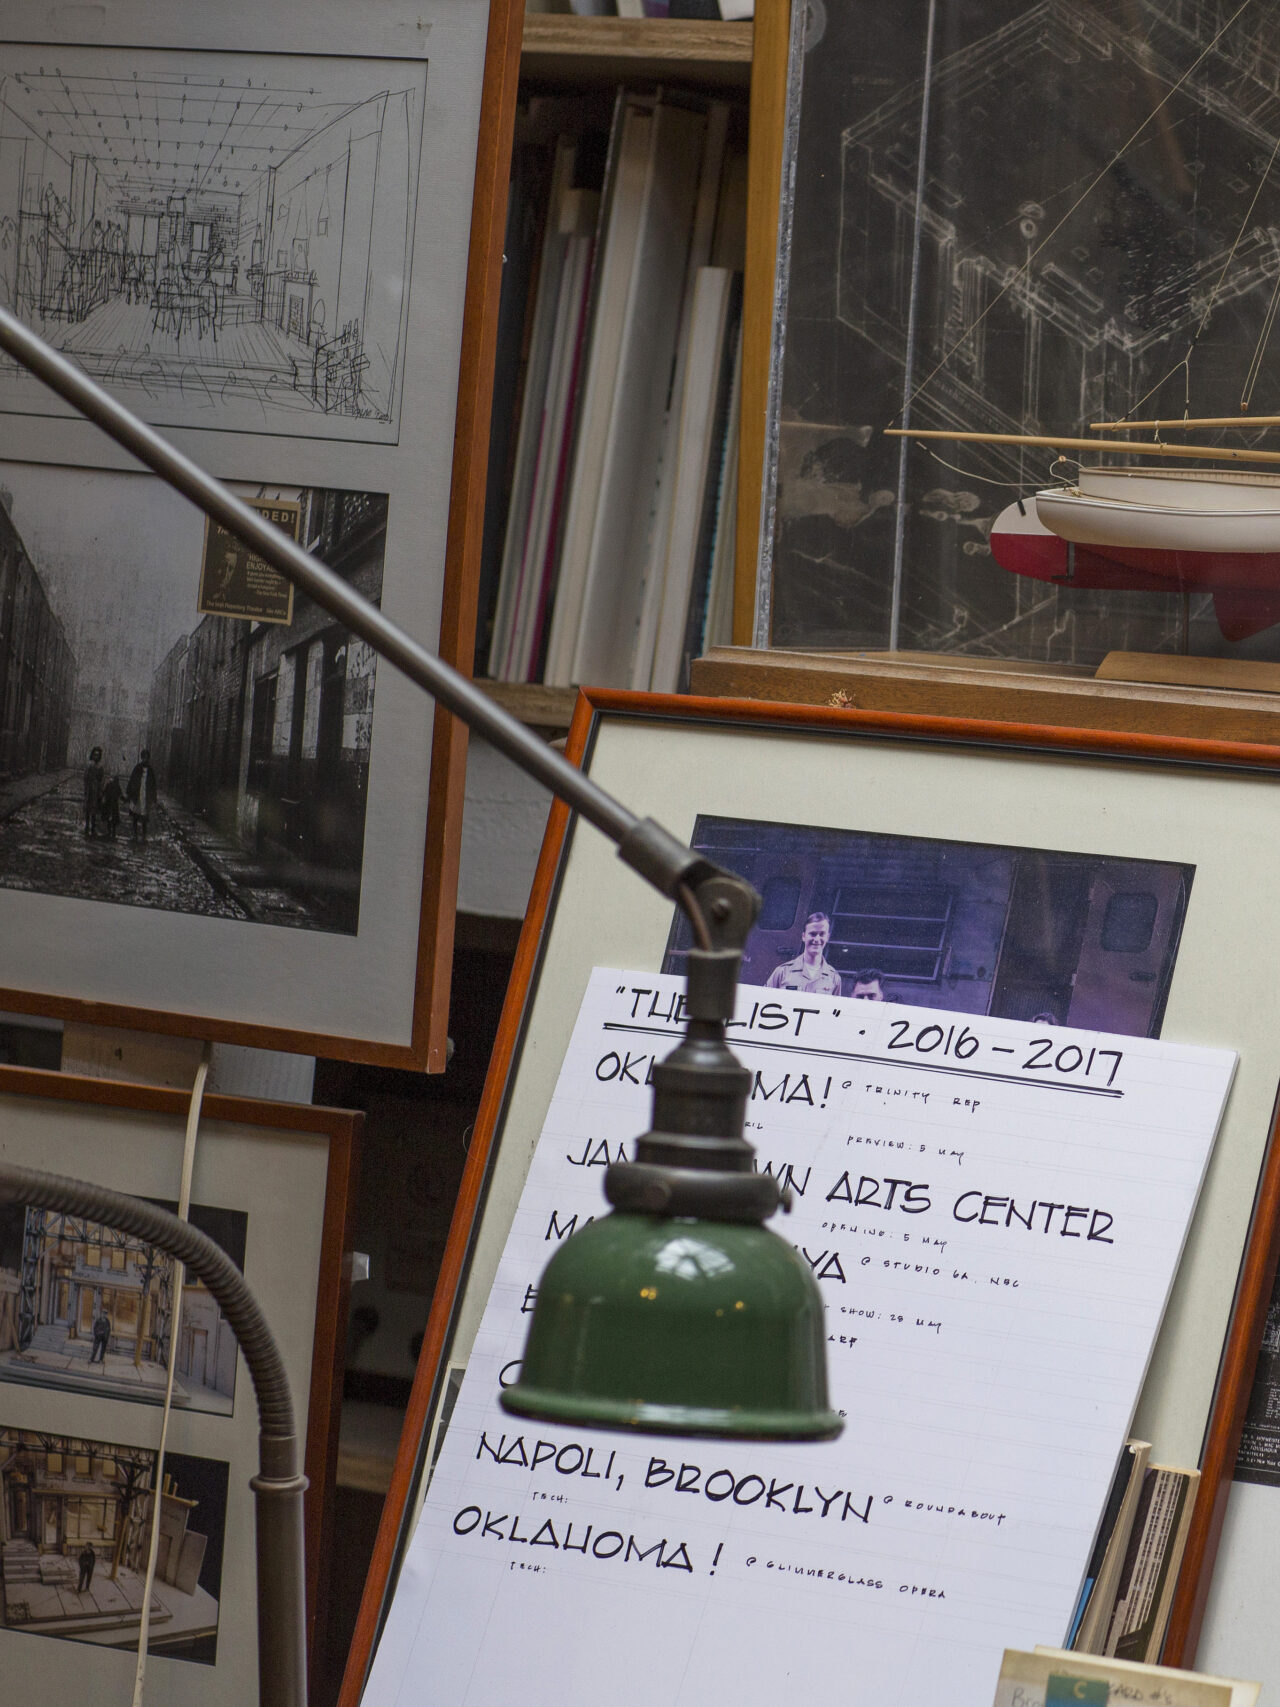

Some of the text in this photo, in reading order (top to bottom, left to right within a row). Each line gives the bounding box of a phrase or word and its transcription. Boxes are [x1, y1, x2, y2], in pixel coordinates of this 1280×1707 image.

[595, 1051, 832, 1109] OKLMA!
[865, 1084, 930, 1104] TRINITY
[953, 1097, 981, 1113] REP
[825, 1170, 931, 1214] ARTS
[953, 1190, 1114, 1244] CENTER
[903, 1233, 910, 1242] 5
[884, 1259, 940, 1276] STUDIO
[990, 1276, 1020, 1288] NBC
[840, 1306, 882, 1320] SHOW:
[476, 1431, 624, 1491] NAPOLI,
[644, 1456, 874, 1523] BROOKLYN
[905, 1499, 1006, 1525] ROUNDABOUT
[532, 1491, 568, 1504] TECH:
[510, 1560, 547, 1573] TECH:
[766, 1560, 883, 1589] GLIMMERGLASS
[899, 1585, 946, 1599] OPERA
[1073, 1681, 1088, 1699] C
